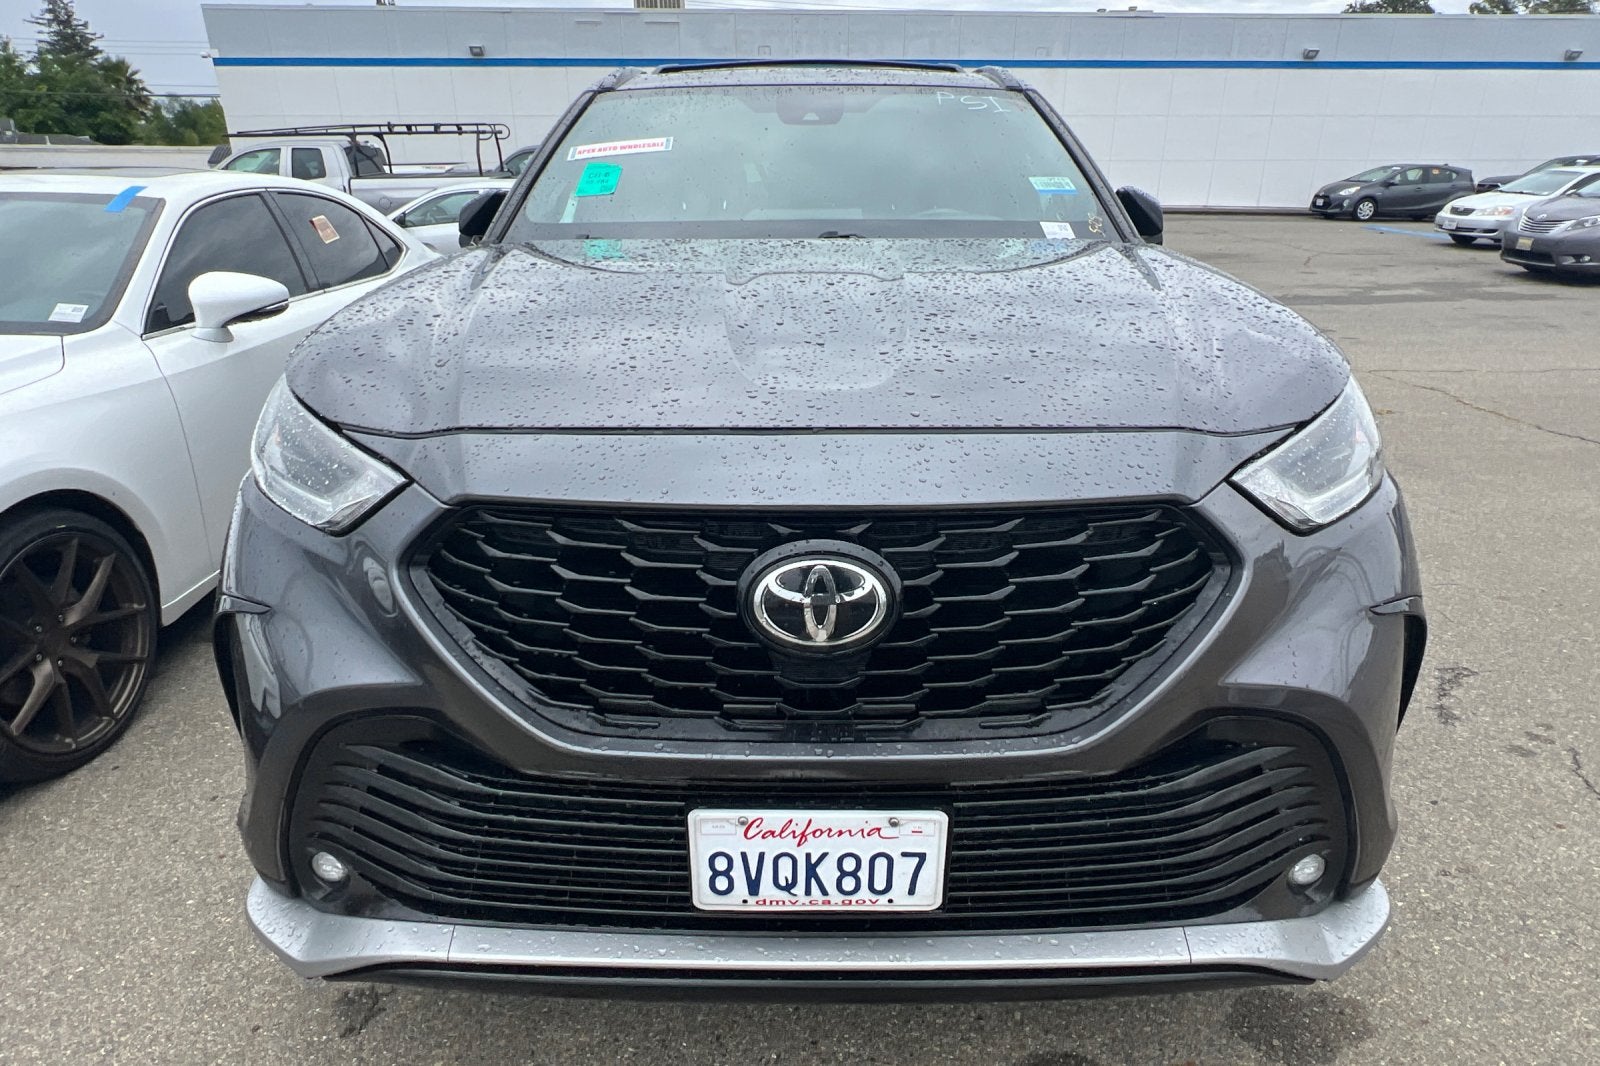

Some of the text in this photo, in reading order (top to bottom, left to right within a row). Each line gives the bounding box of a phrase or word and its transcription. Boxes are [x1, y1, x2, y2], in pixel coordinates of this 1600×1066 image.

[936, 91, 1011, 113] PSI
[597, 145, 618, 153] AUTO
[619, 142, 665, 151] WHOLESALE
[743, 817, 900, 847] California
[708, 851, 927, 896] 8VQK807
[755, 898, 880, 906] dmv.ca.gov
